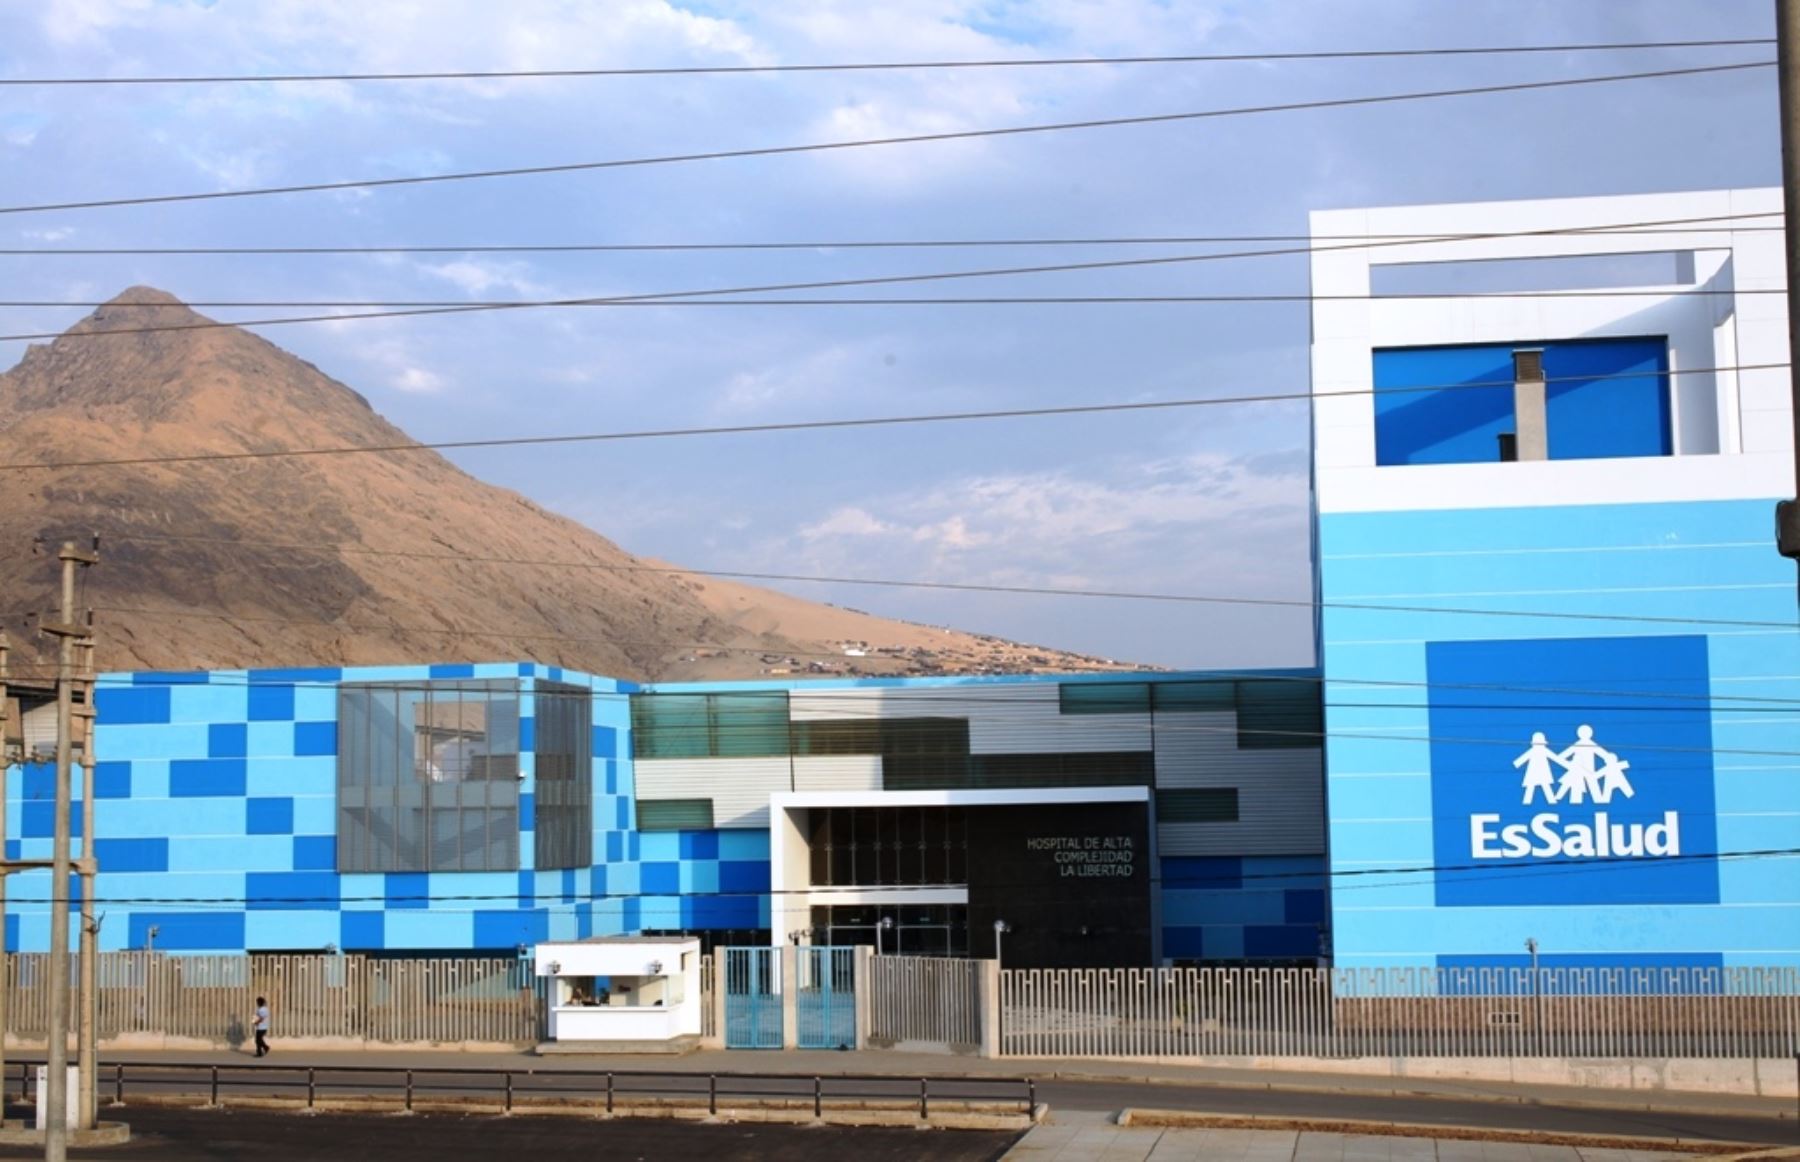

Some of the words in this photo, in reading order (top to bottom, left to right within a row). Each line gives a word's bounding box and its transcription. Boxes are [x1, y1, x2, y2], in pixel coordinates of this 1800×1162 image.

[1470, 811, 1680, 858] EsSalud
[1027, 837, 1081, 849] HOSPITAL
[1084, 837, 1100, 849] DE
[1103, 837, 1132, 849] ALTA
[1060, 864, 1074, 876] LA
[1077, 864, 1133, 876] LIBERTAD
